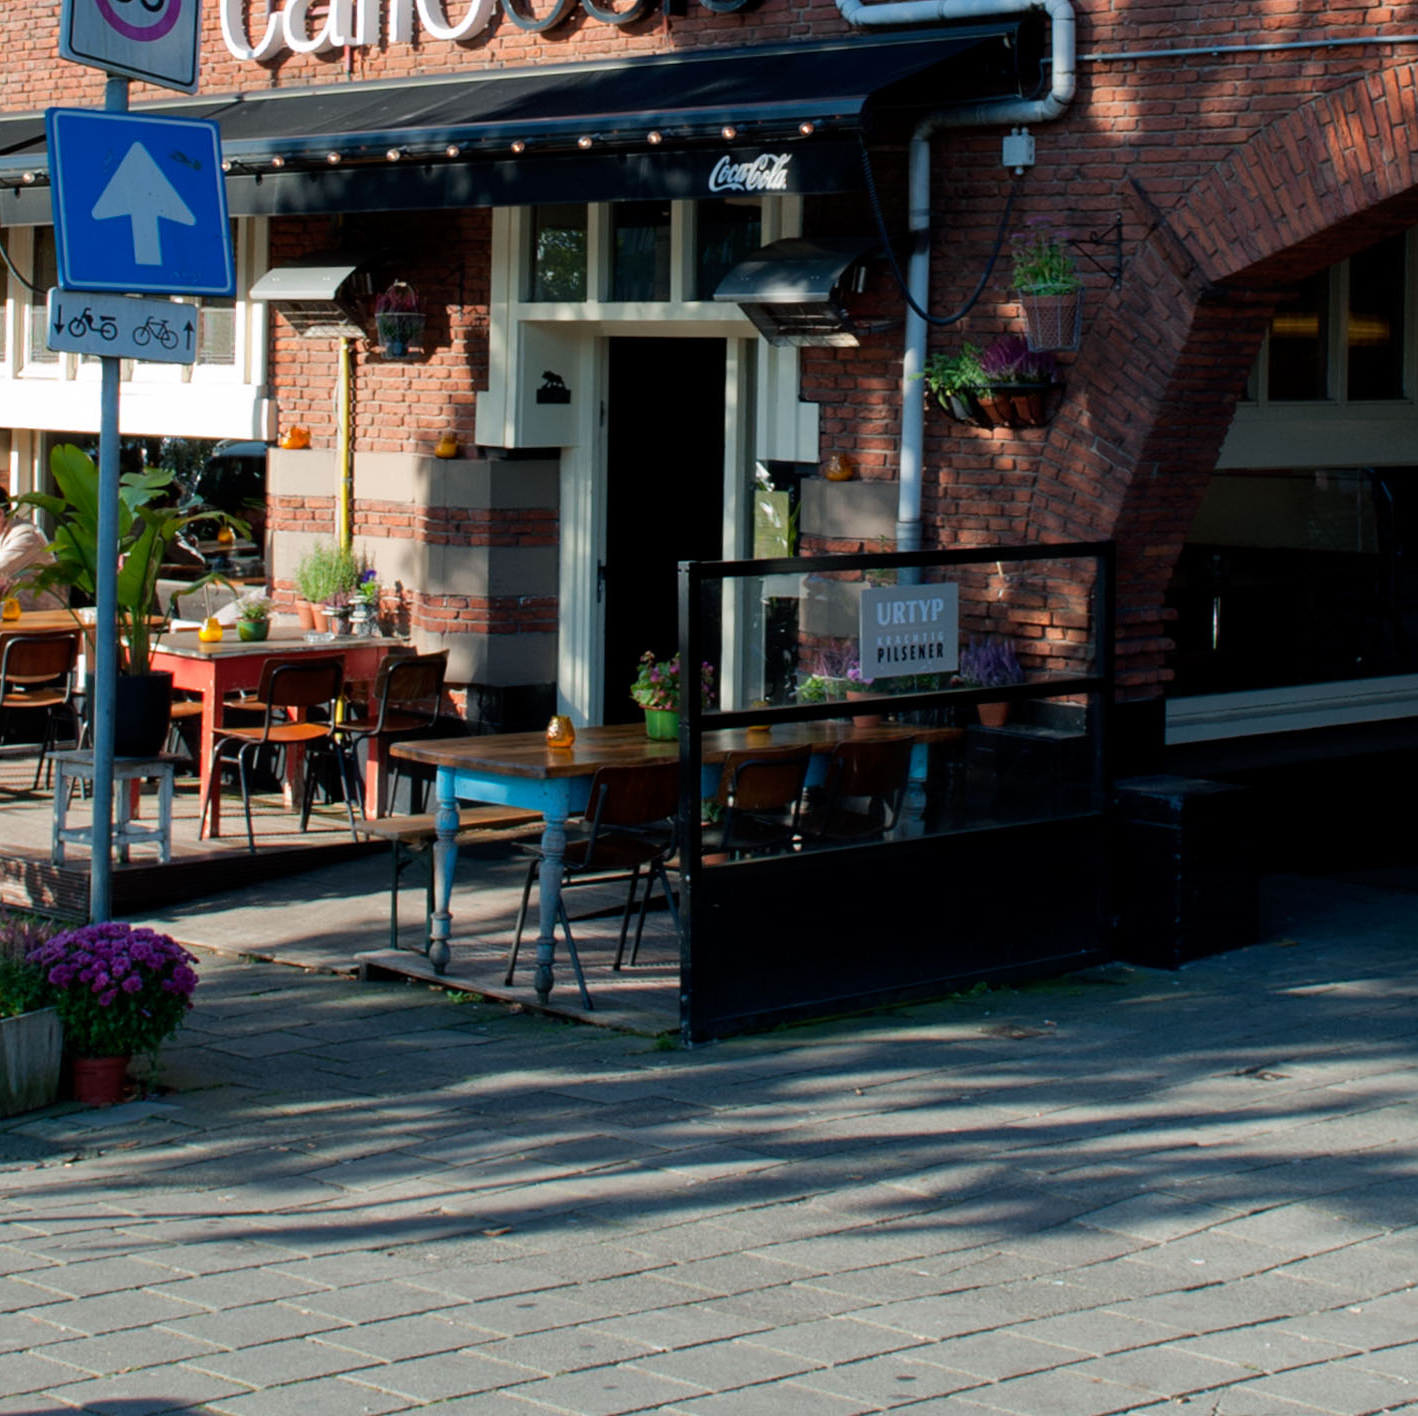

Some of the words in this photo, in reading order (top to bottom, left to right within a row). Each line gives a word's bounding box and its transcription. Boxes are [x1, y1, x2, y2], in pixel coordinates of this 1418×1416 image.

[876, 597, 944, 627] URTYP
[876, 631, 945, 647] KRACHTIG
[876, 642, 944, 664] PILSENER
